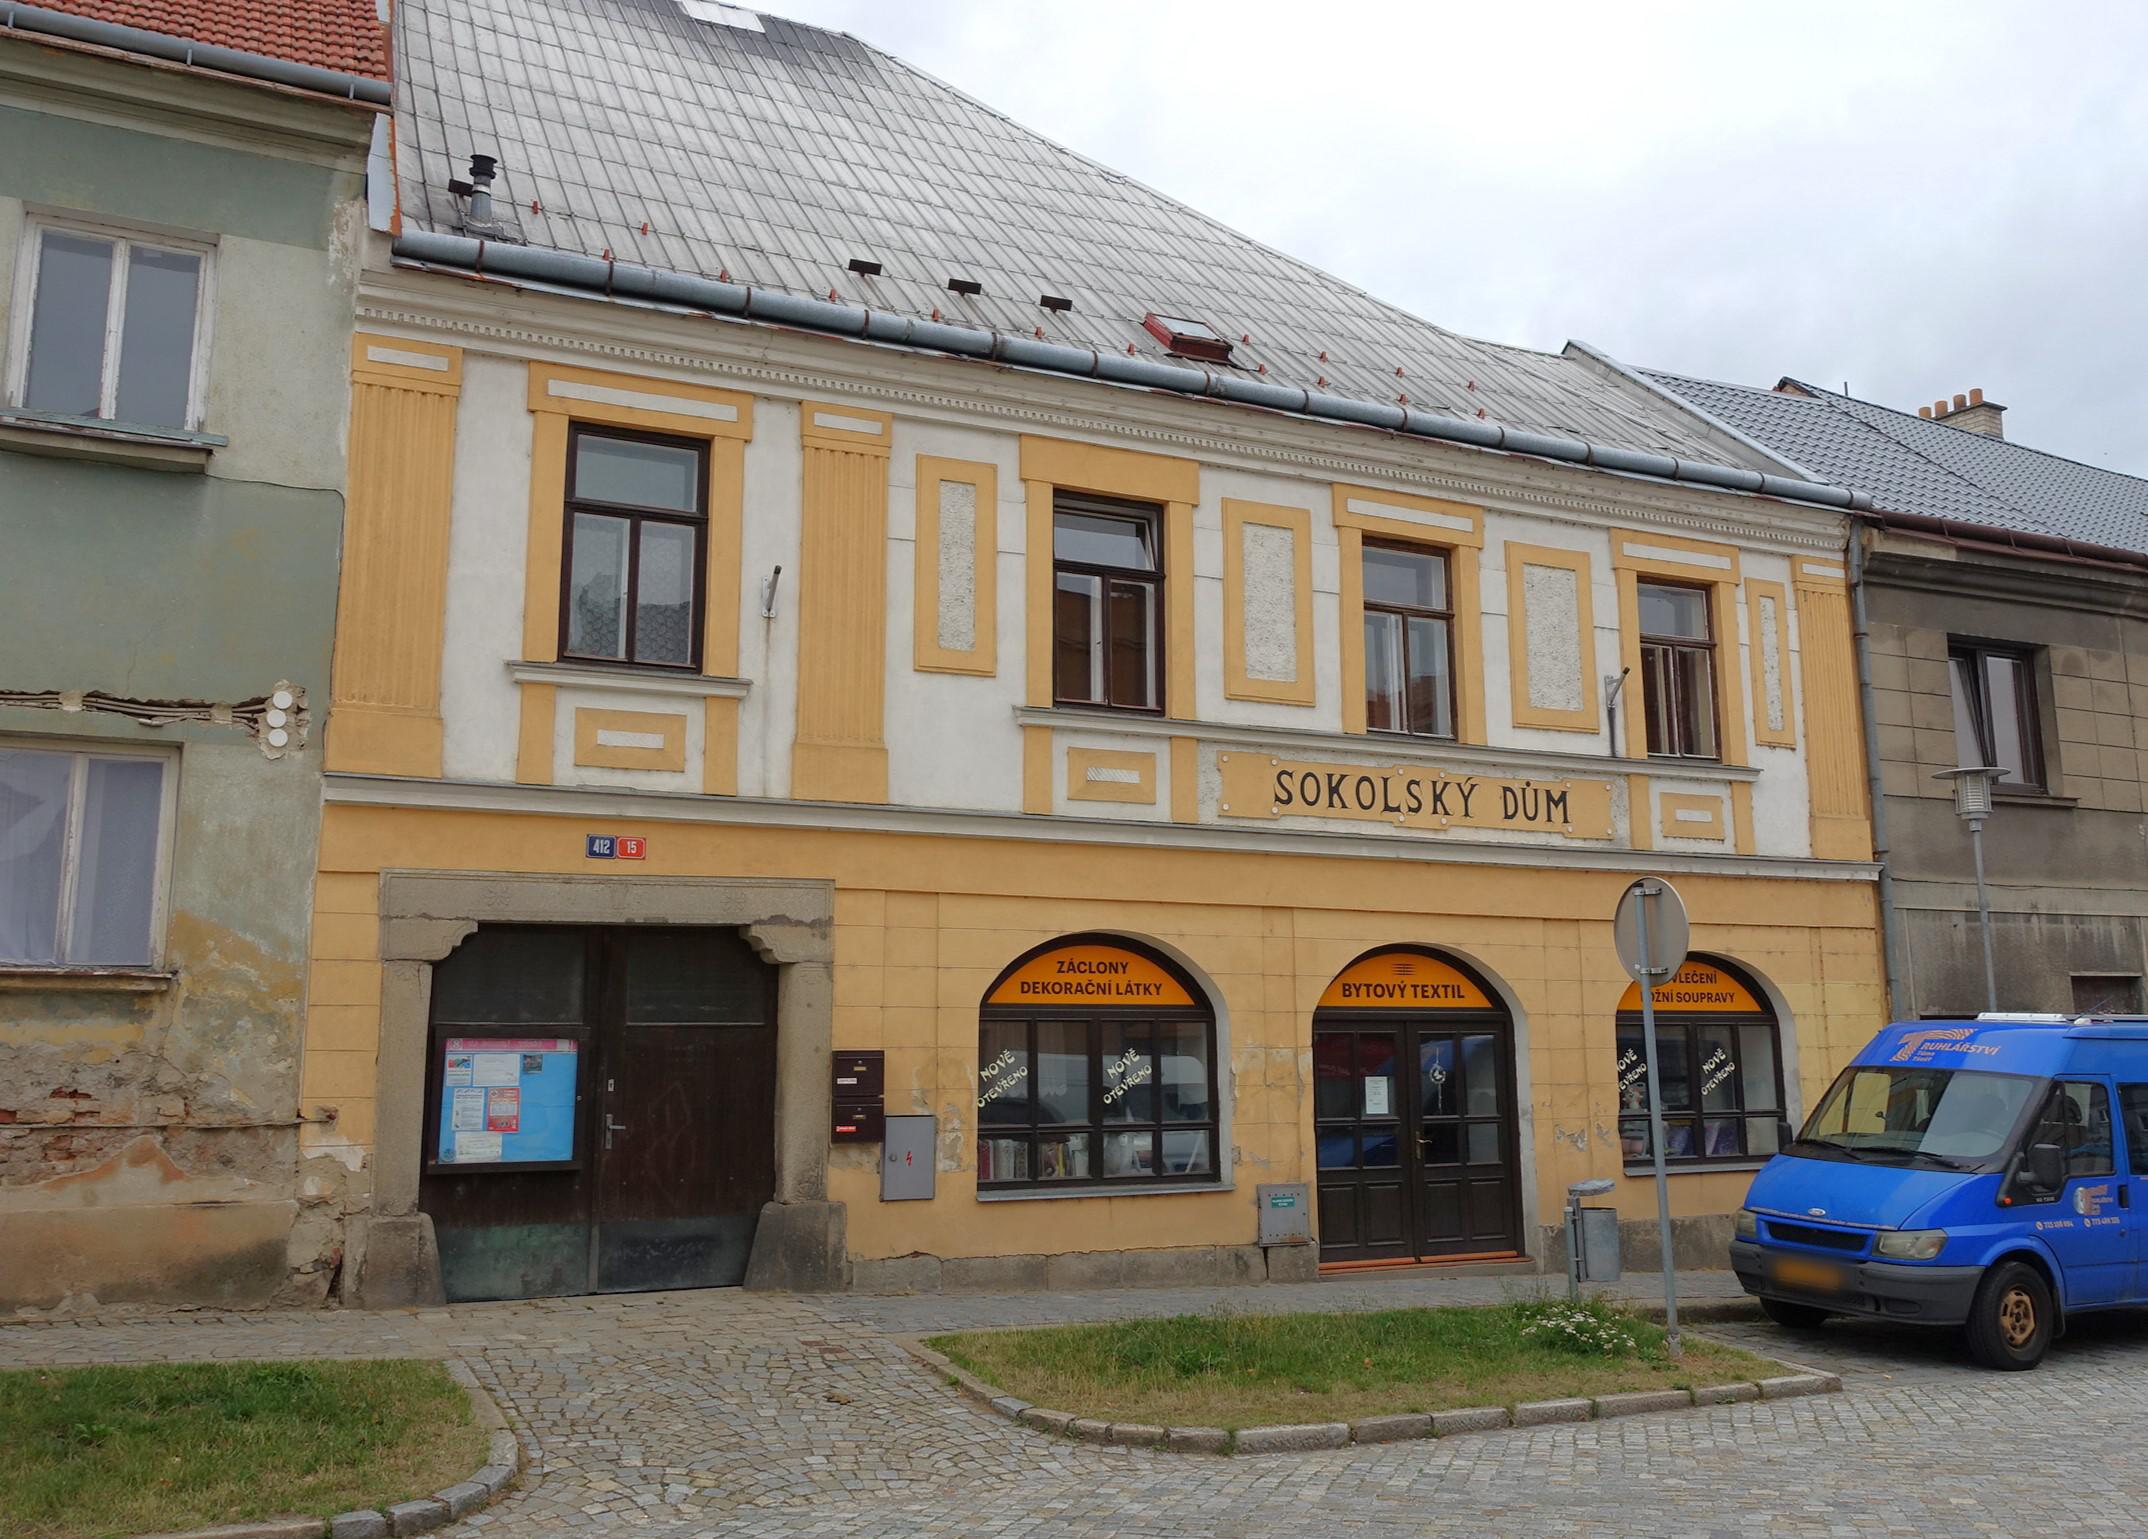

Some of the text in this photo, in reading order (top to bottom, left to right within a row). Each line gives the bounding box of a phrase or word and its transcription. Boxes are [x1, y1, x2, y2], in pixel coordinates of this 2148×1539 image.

[1274, 769, 1570, 824] SOKOLSKÝ DŮM
[593, 839, 610, 854] 412
[626, 841, 637, 854] 15
[1057, 958, 1129, 975] ZÁCLONY
[1672, 970, 1718, 984] VLEČENÍ
[1020, 979, 1162, 996] DEKORAČNÍ LÁTKY
[1342, 980, 1465, 1000] BYTOVÝ TEXTIL
[1641, 989, 1735, 1003] ŽNÍ SOUPRAVY
[979, 1049, 1016, 1082] NOVĚ
[1106, 1048, 1141, 1079] NOVĚ
[1701, 1048, 1727, 1074] NOVĚ
[977, 1066, 1028, 1108] OTEVŘENO
[1103, 1064, 1153, 1105] OTEVŘENO
[1618, 1063, 1648, 1092] EVŘENO
[1701, 1062, 1736, 1096] OTEVŘENO
